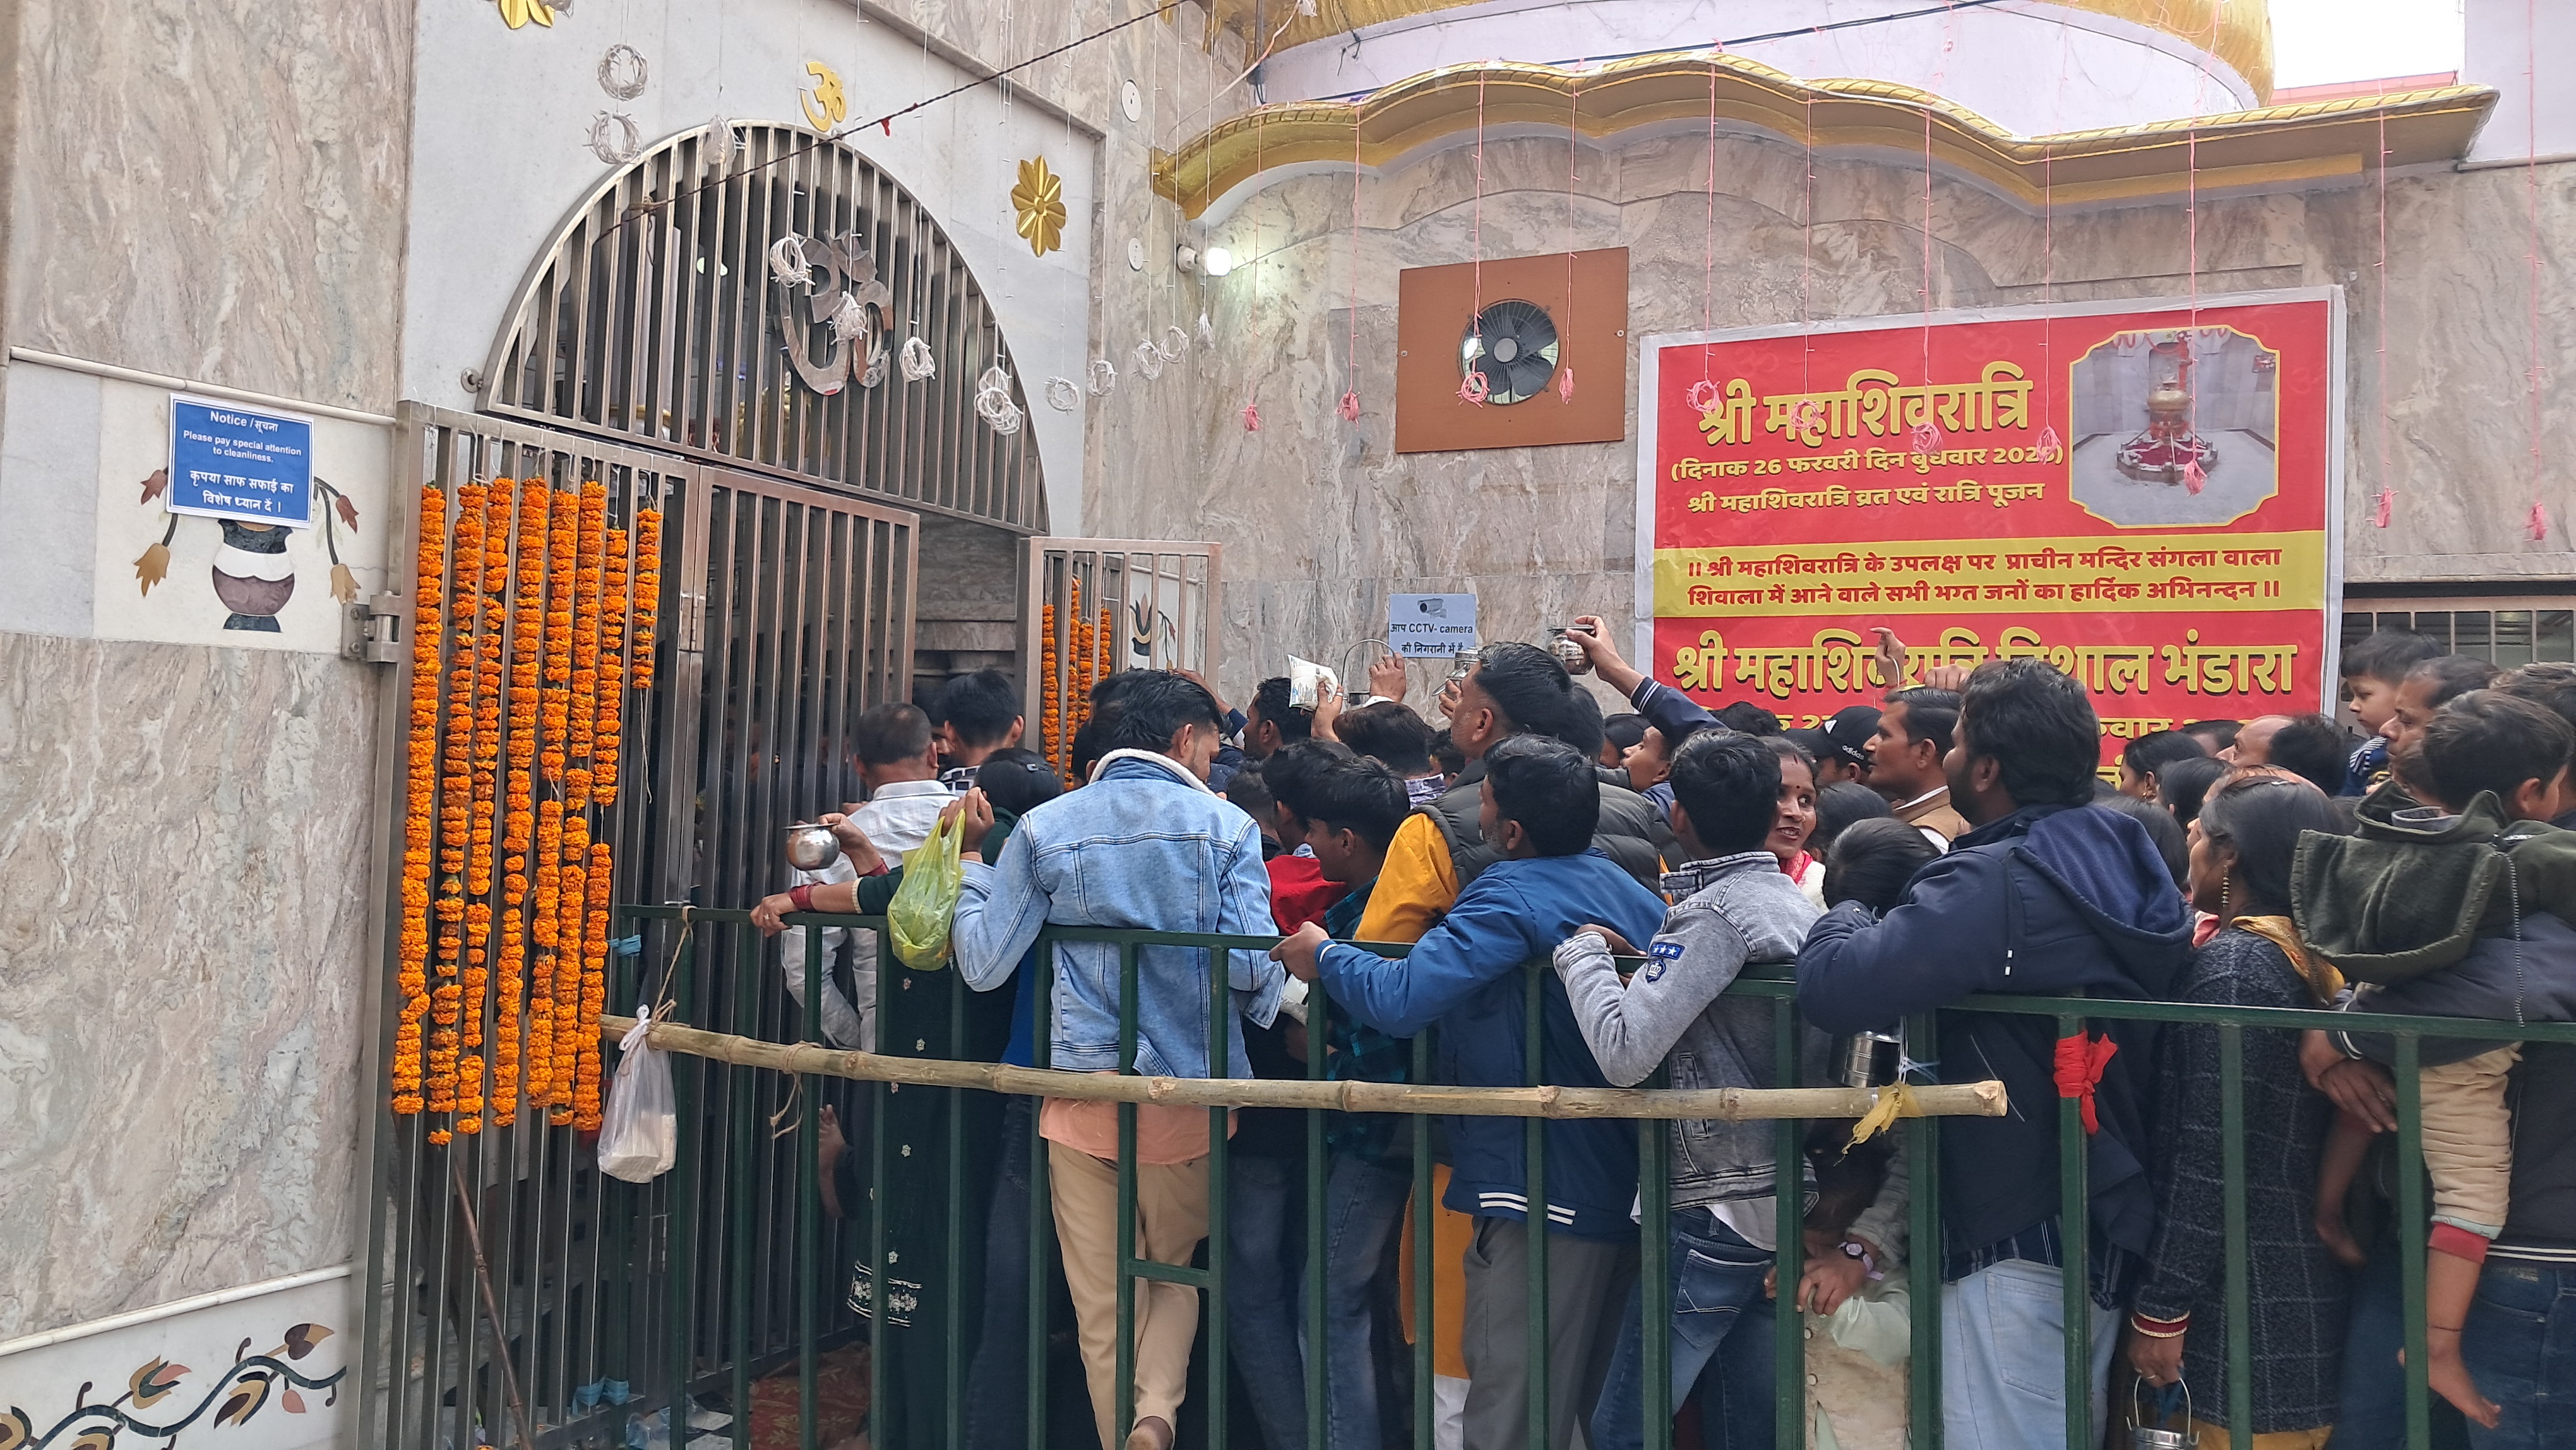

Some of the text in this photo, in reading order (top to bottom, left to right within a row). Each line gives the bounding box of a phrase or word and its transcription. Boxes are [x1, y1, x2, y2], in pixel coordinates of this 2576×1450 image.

[1698, 361, 2034, 446] श्री महाशिवरात्रि
[210, 411, 247, 427] Notice
[183, 429, 302, 456] Please pay special attention
[213, 446, 274, 462] to cleanliness.
[1671, 457, 1749, 481] (दिनाक
[1754, 459, 1782, 476] 26
[1786, 448, 1861, 473] फरवरी
[1864, 447, 1907, 471] दिन
[189, 470, 294, 494] कृपया साफ सफाई का
[203, 489, 232, 506] विशेष
[234, 497, 262, 510] ध्यान
[1687, 479, 2046, 513] श्री महाशिवरात्रि व्रत एवं रात्रि पूजन
[1707, 555, 1734, 577] श्री
[1736, 553, 1861, 577] महाशिवरात्रि
[1863, 552, 1887, 573] के
[1890, 554, 1963, 574] उपलक्ष
[1966, 554, 1996, 570] पर
[2005, 547, 2075, 570] प्राचीन
[2078, 546, 2143, 571] मन्दिर
[2146, 546, 2218, 567] संगला
[2222, 549, 2282, 566] वाला
[1688, 585, 1764, 605] शिवाला
[1767, 584, 1786, 604] में
[1790, 582, 1833, 603] आने
[1837, 582, 1881, 602] वाले
[1884, 580, 1931, 601] सभी
[1983, 578, 2029, 601] जनों
[2032, 584, 2065, 599] का
[2069, 577, 2142, 602] हार्दिक
[2146, 576, 2257, 600] अभिनन्दन
[1390, 623, 1407, 633] आप
[1440, 625, 1473, 633] camera
[1402, 642, 1412, 653] की
[1414, 642, 1446, 654] निगरानी
[1673, 629, 1728, 691] श्री
[2161, 628, 2298, 694] भंडारा
[1842, 745, 1865, 760] adidas
